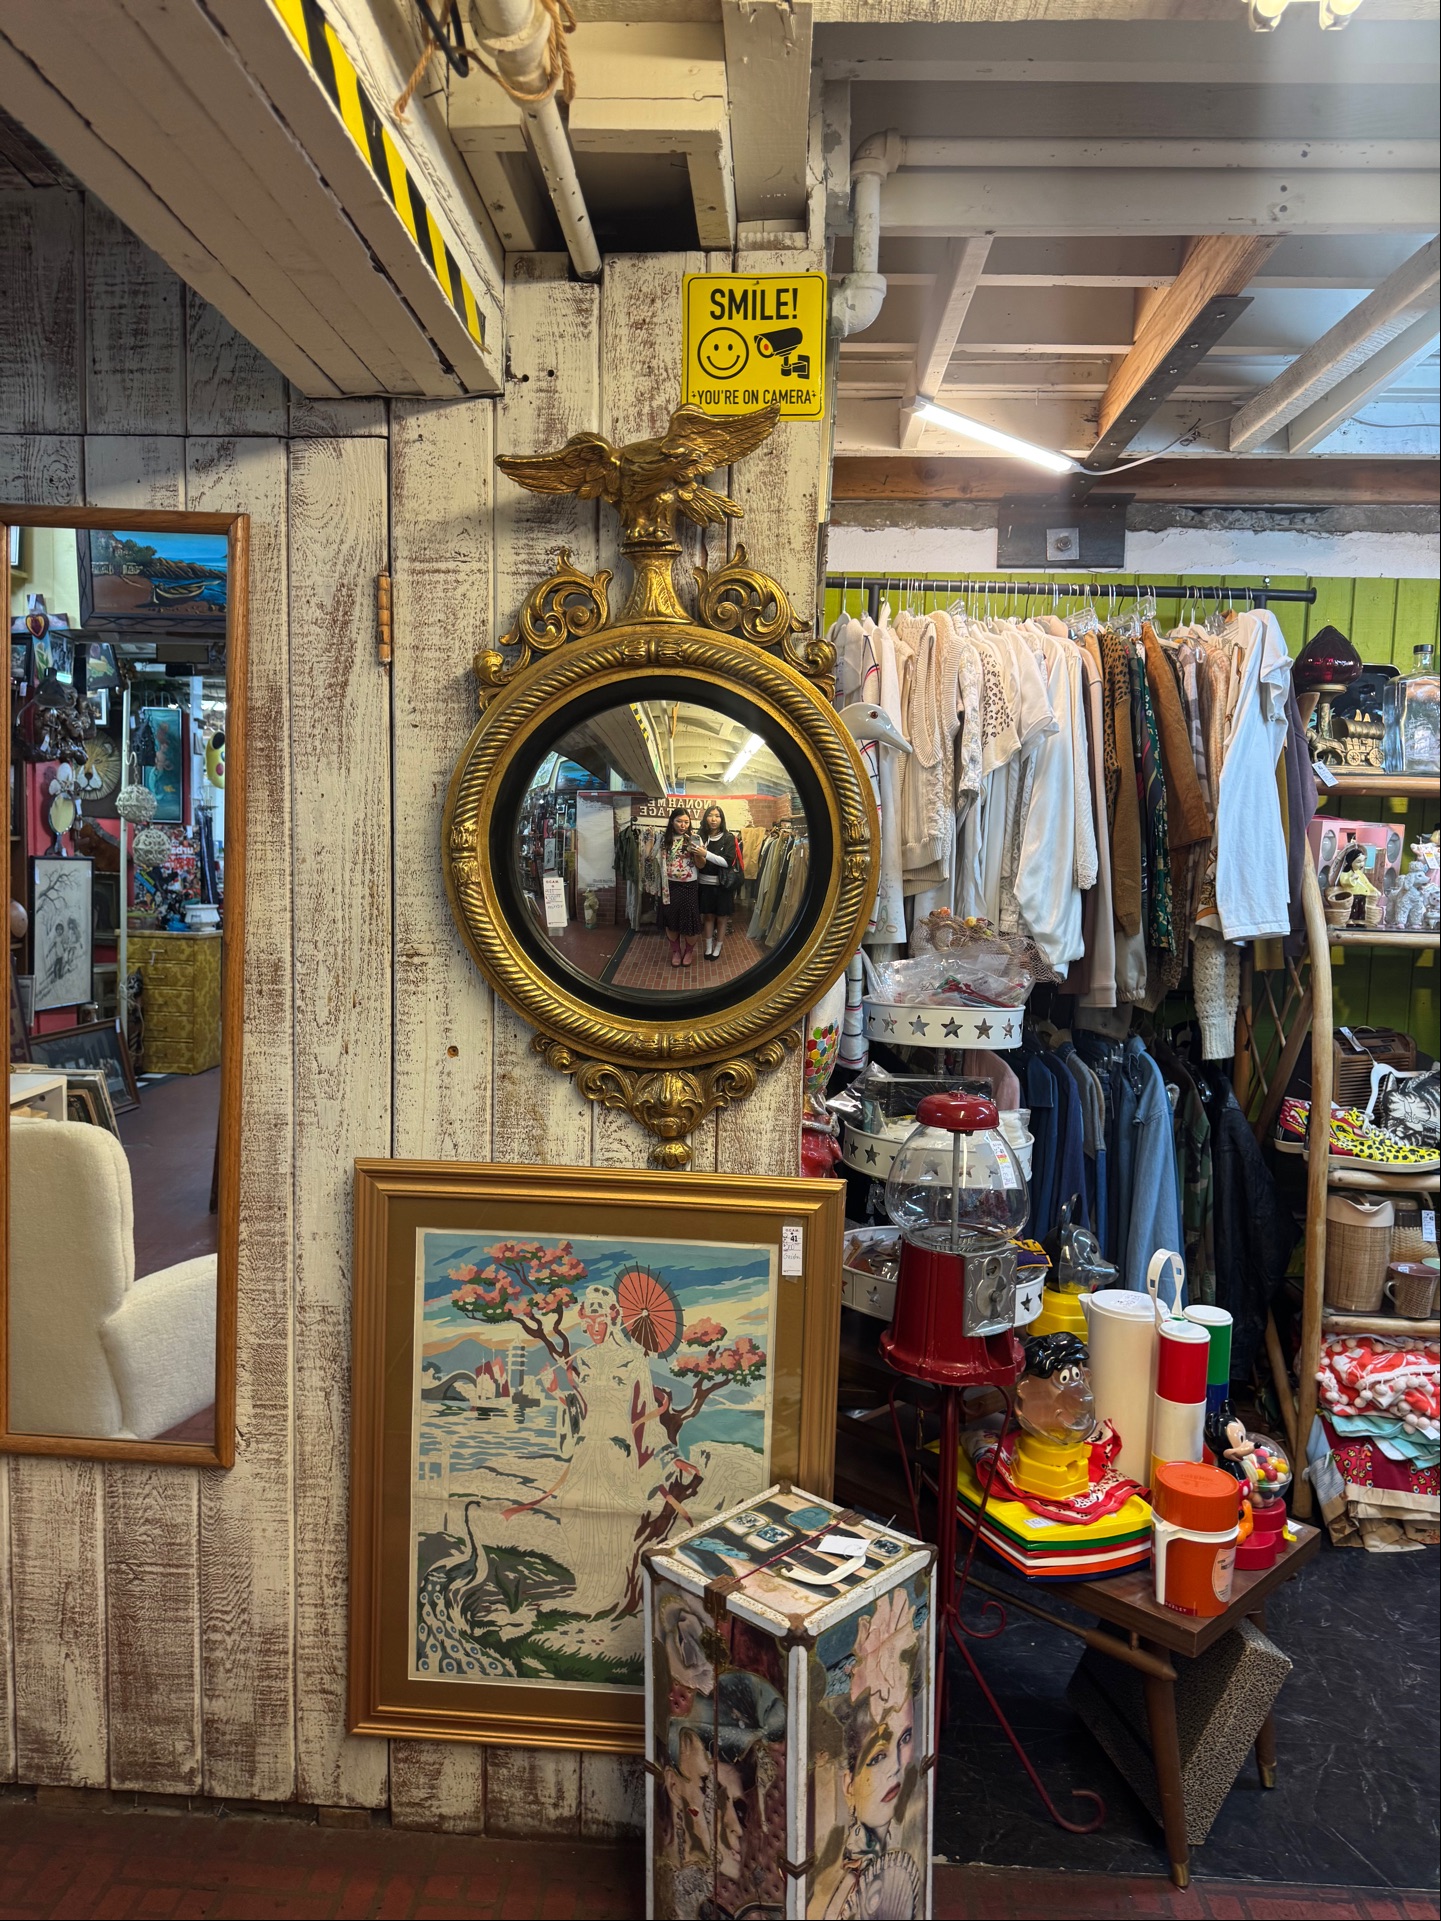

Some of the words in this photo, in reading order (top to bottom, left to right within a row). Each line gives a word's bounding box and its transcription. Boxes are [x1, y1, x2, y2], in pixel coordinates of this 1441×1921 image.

[709, 287, 799, 321] SMILE!
[697, 389, 740, 405] YOU'RE
[743, 389, 759, 405] ON
[763, 389, 812, 405] CAMERA
